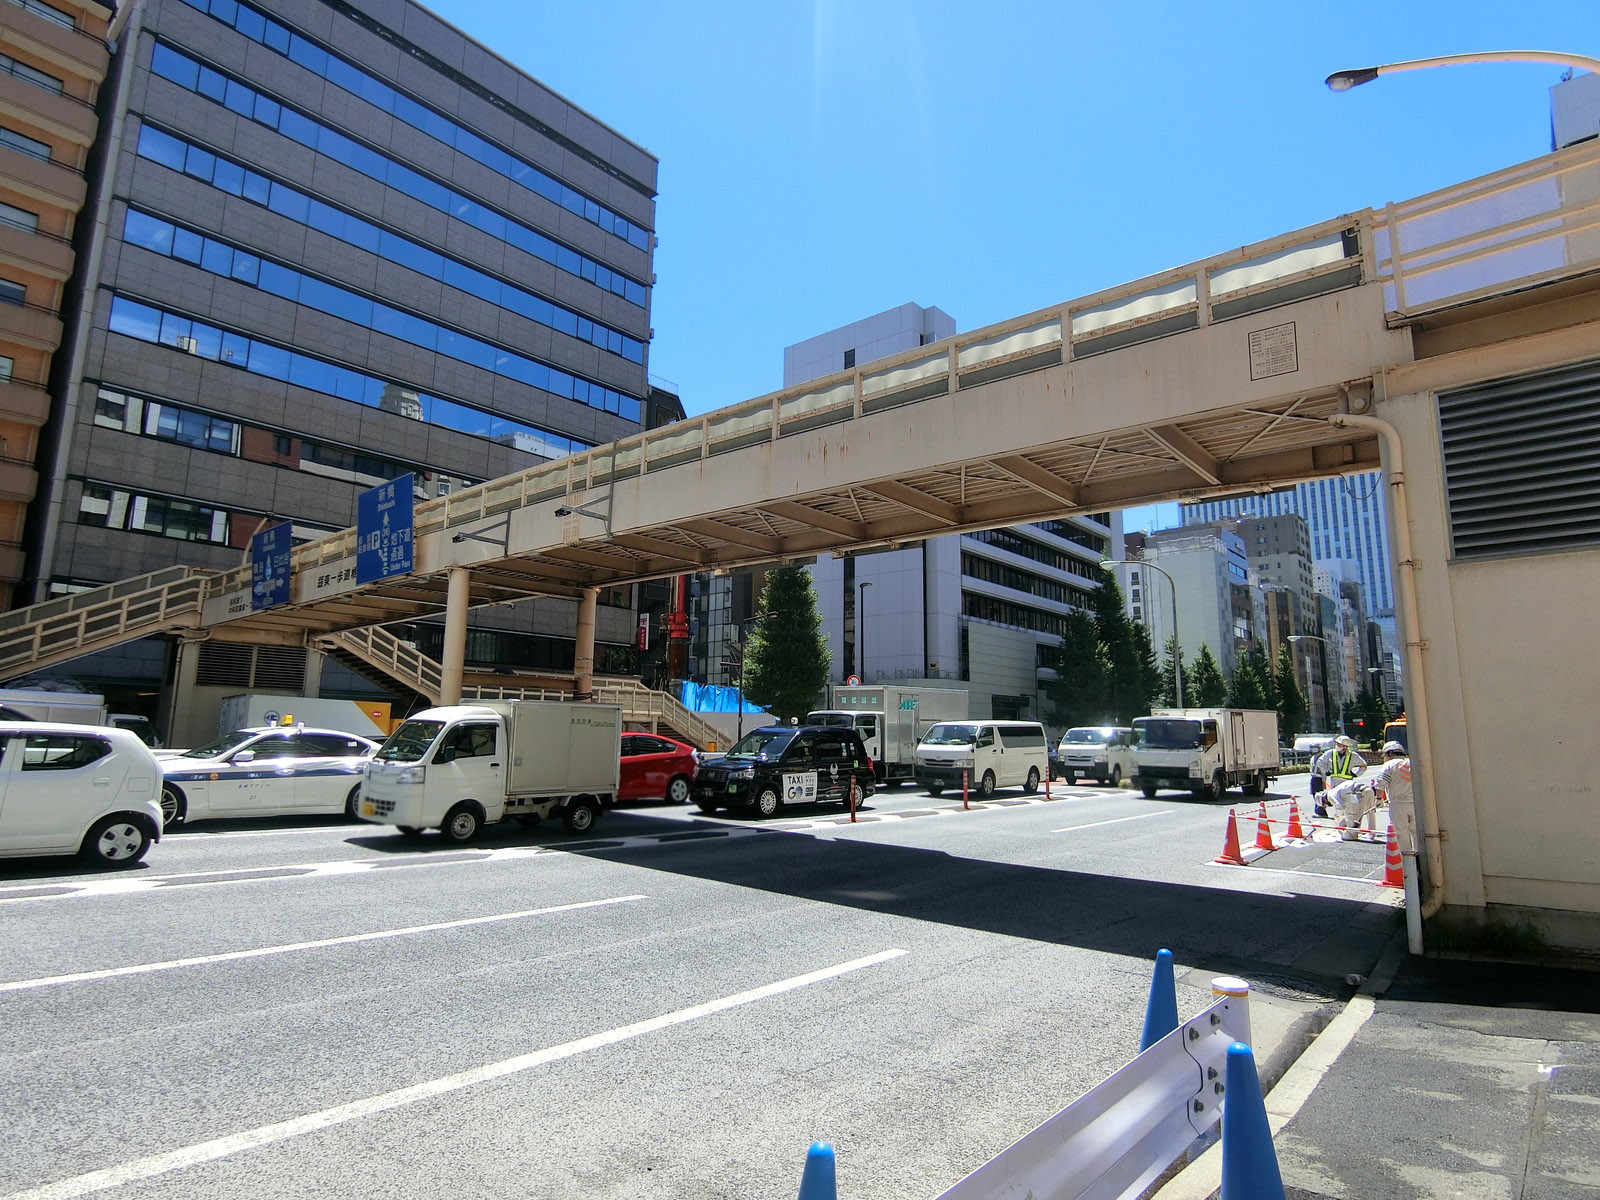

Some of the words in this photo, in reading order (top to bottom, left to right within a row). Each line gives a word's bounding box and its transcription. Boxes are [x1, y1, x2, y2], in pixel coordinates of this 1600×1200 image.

[391, 528, 411, 546] 地下道
[391, 545, 404, 561] 通過
[787, 776, 804, 785] TAXI
[787, 786, 803, 800] GO
